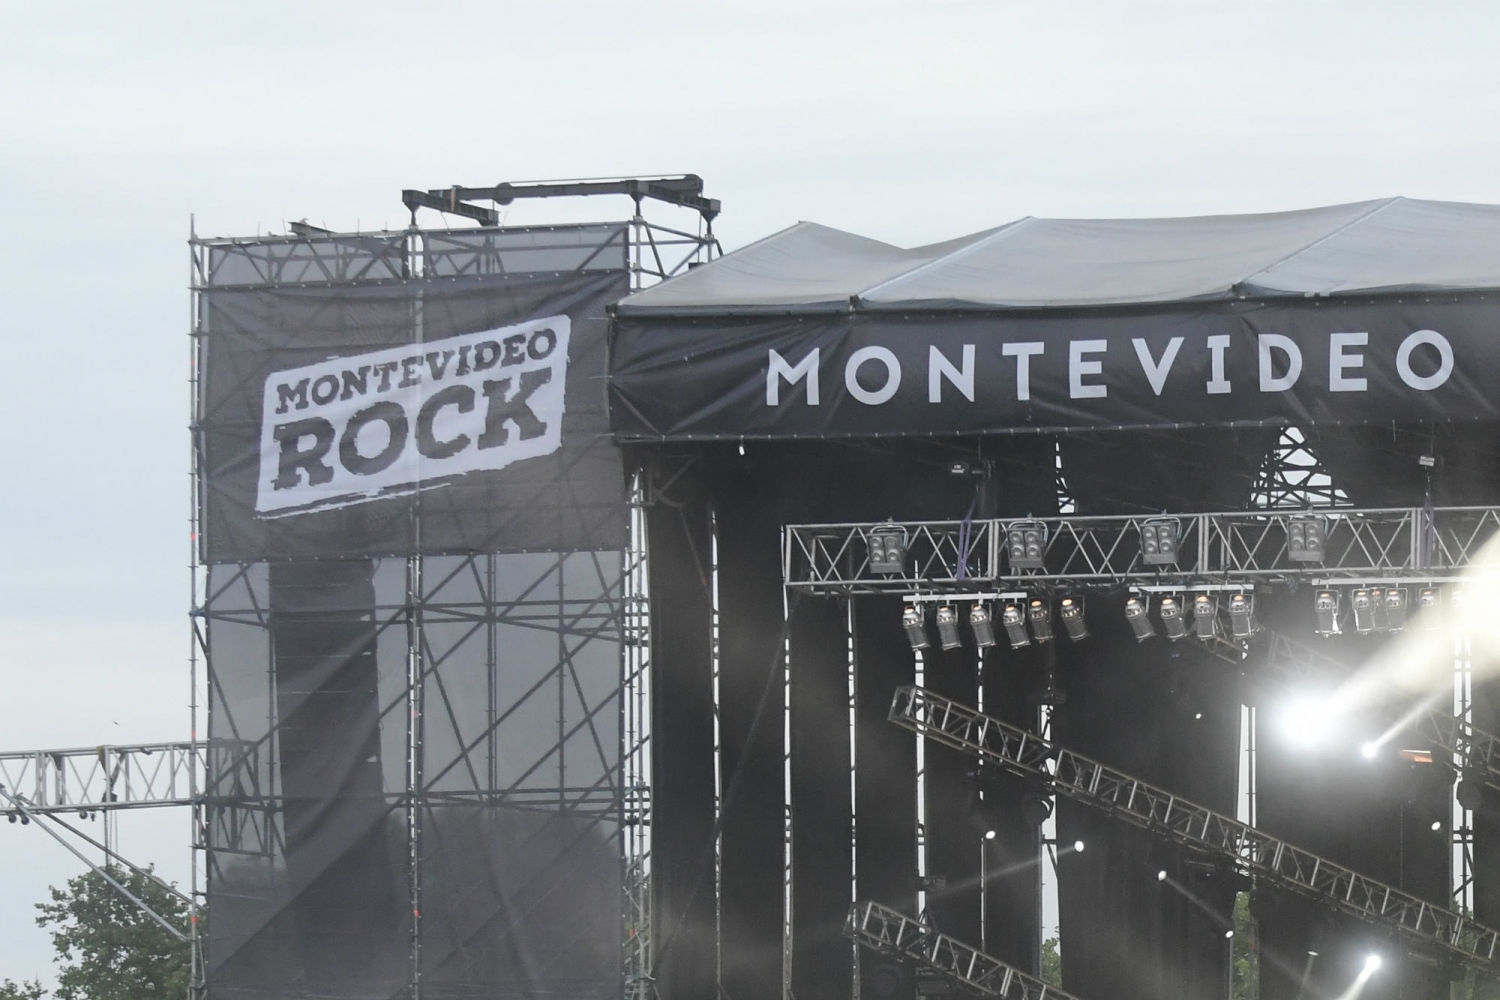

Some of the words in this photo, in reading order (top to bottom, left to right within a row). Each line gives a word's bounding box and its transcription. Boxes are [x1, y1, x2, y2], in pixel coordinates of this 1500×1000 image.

[275, 327, 558, 415] MONTEVIDEO
[765, 328, 1454, 406] MONTEVIDEO
[270, 367, 553, 491] ROCK
